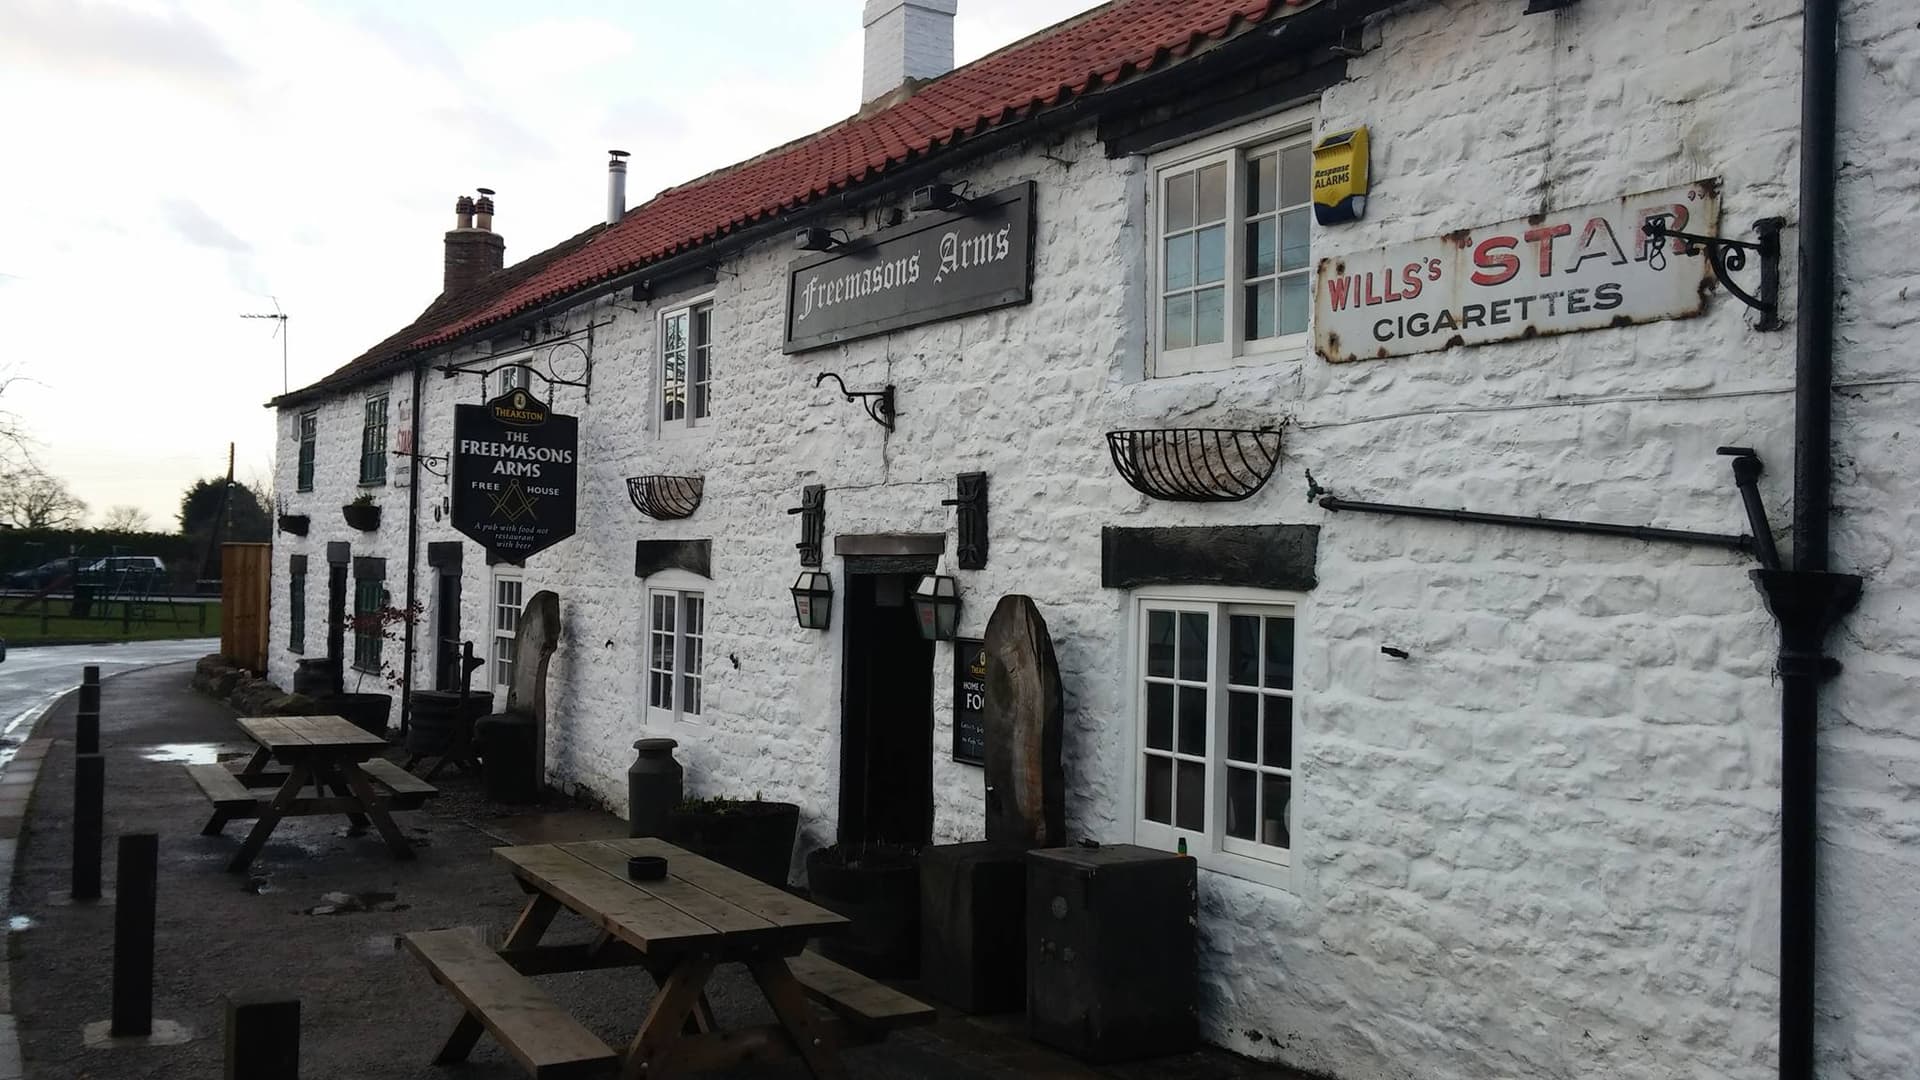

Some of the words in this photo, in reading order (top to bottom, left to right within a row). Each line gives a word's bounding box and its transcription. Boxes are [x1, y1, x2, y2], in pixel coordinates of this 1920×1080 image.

[1315, 165, 1349, 178] Response
[1315, 173, 1350, 189] ALARMS
[798, 250, 921, 323] Freemasons
[934, 223, 1011, 285] Arms
[1373, 283, 1623, 342] CIGARETTES
[495, 406, 543, 421] THEAKSTON
[505, 431, 529, 443] THE
[460, 439, 573, 464] FREEMASONS
[492, 460, 541, 478] ARMS
[471, 481, 500, 491] FREE
[527, 486, 560, 496] HOUSE
[474, 521, 481, 530] A
[482, 522, 498, 532] pub
[500, 523, 517, 533] with
[518, 524, 535, 536] food
[537, 526, 549, 535] not
[495, 532, 534, 541] restaurant
[496, 540, 513, 548] with
[963, 682, 979, 691] HOME
